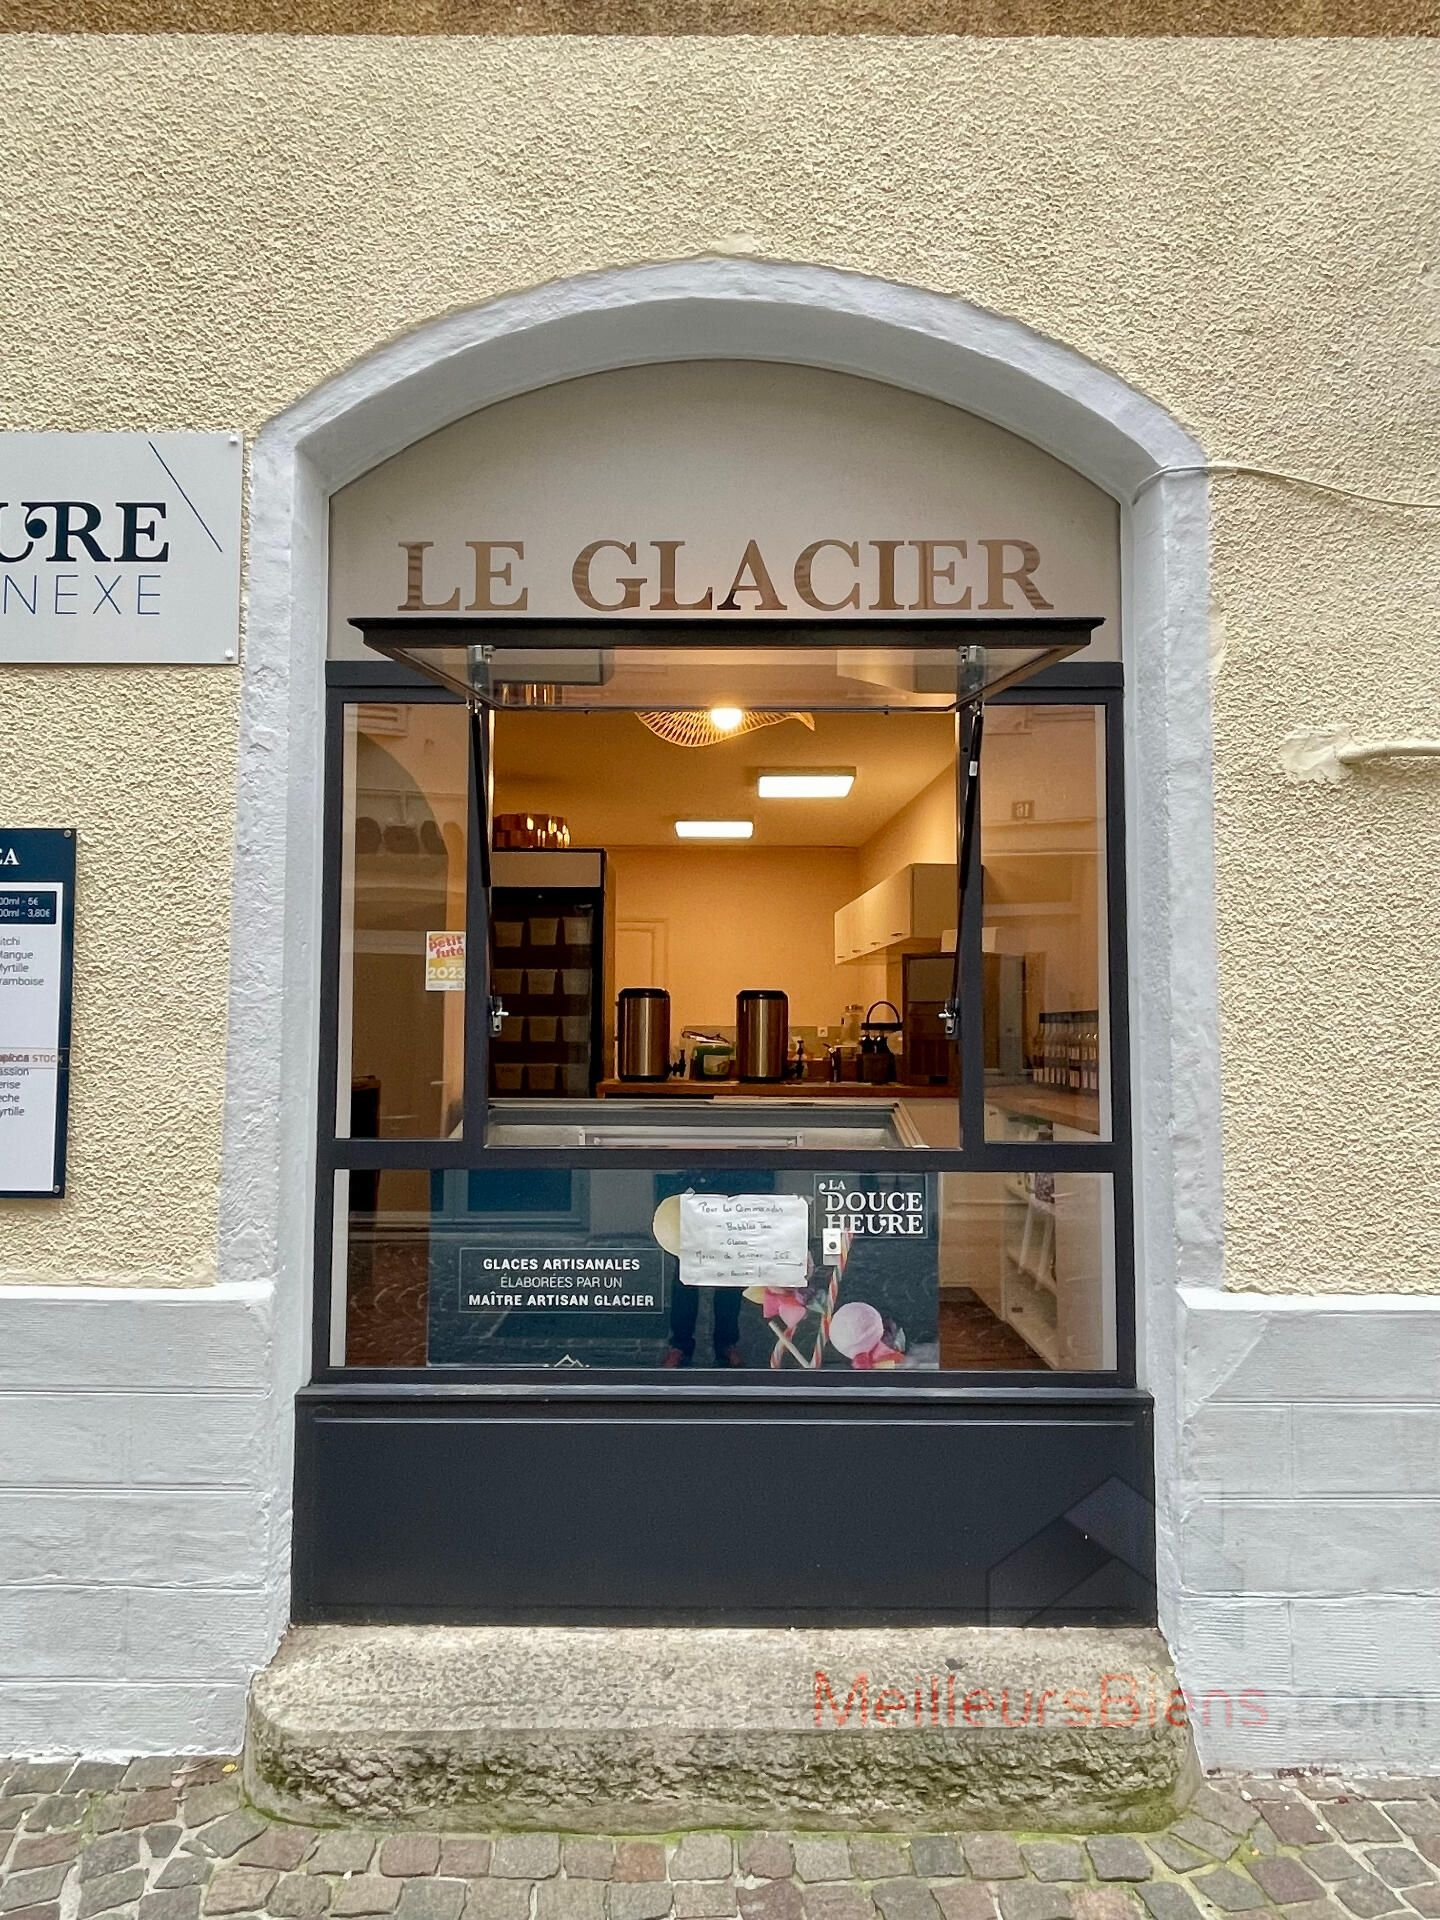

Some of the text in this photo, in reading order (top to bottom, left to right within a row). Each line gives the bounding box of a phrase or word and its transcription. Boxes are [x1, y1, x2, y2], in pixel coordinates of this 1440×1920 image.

[398, 539, 1054, 612] LE GLACIER
[4, 574, 161, 615] NEXE
[428, 967, 465, 979] 2023
[828, 1180, 846, 1190] LA
[819, 1189, 923, 1212] DOUCE
[825, 1214, 924, 1234] HEURE
[483, 1258, 640, 1270] GLACES ARTISANALES
[500, 1273, 622, 1288] ÉLABORÉES PAR UN
[468, 1291, 654, 1306] MAÎTRE ARTISAN GLACIER
